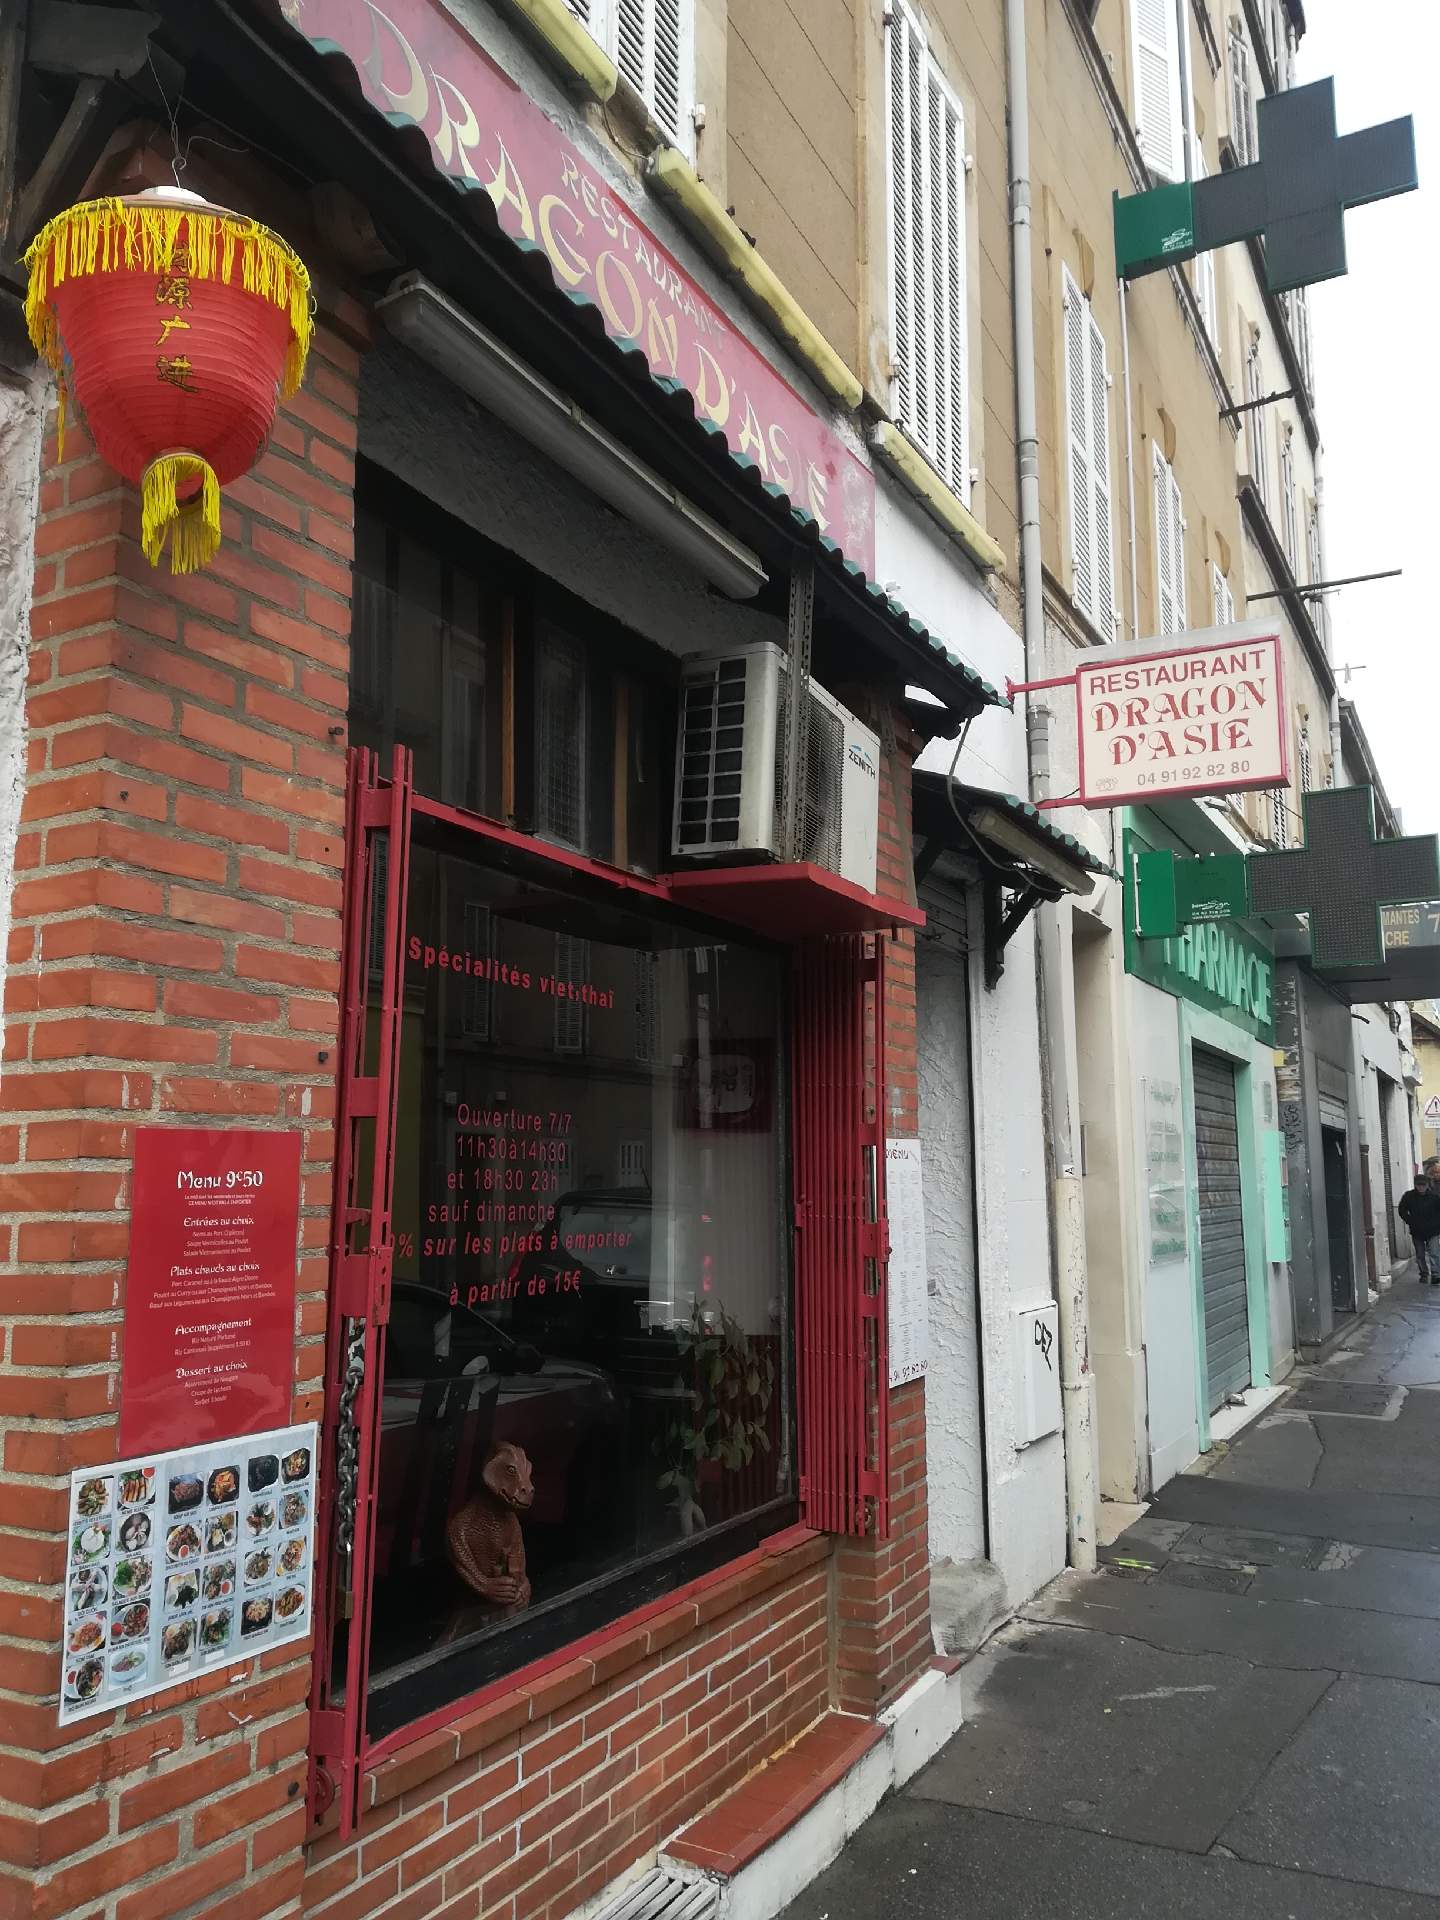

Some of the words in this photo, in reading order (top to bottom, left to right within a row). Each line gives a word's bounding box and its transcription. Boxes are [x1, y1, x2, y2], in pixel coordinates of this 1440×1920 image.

[362, 0, 678, 378] DRAGON
[694, 340, 832, 531] D'ASE
[560, 152, 728, 352] RESTAURANT
[1090, 649, 1266, 696] RESTAURANT
[1091, 678, 1267, 732] DRAGON
[1109, 718, 1254, 766] D'ASIE
[849, 748, 876, 780] ZENITH
[1137, 773, 1156, 786] 04
[1161, 770, 1178, 783] 91
[1182, 766, 1201, 779] 92
[1207, 763, 1225, 777] 82
[1231, 760, 1250, 774] 80
[409, 936, 531, 989] Spécialités
[457, 1103, 542, 1132] Ouverture
[549, 1112, 572, 1134] 7/7
[456, 1137, 566, 1163] 11h30à14h30
[177, 1170, 222, 1189] Menu
[447, 1171, 463, 1190] et
[473, 1168, 524, 1191] 18h30
[531, 1170, 559, 1192] 23h
[183, 1216, 218, 1227] Entrées
[220, 1217, 231, 1226] au
[232, 1214, 254, 1225] choix
[428, 1200, 469, 1223] sauf
[476, 1201, 555, 1223] dimanche
[424, 1236, 457, 1256] sur
[464, 1231, 491, 1254] les
[500, 1231, 543, 1258] plats
[550, 1231, 559, 1250] à
[565, 1230, 633, 1254] emporter
[170, 1265, 193, 1277] Plats
[194, 1263, 225, 1275] chauds
[238, 1261, 260, 1271] choix
[449, 1282, 458, 1306] à
[467, 1277, 520, 1309] partir
[527, 1274, 546, 1296] de
[554, 1270, 582, 1292] 15€
[174, 1317, 252, 1336] Accompagnement
[175, 1364, 212, 1379] Dessert
[213, 1364, 224, 1373] au
[225, 1359, 248, 1371] choix
